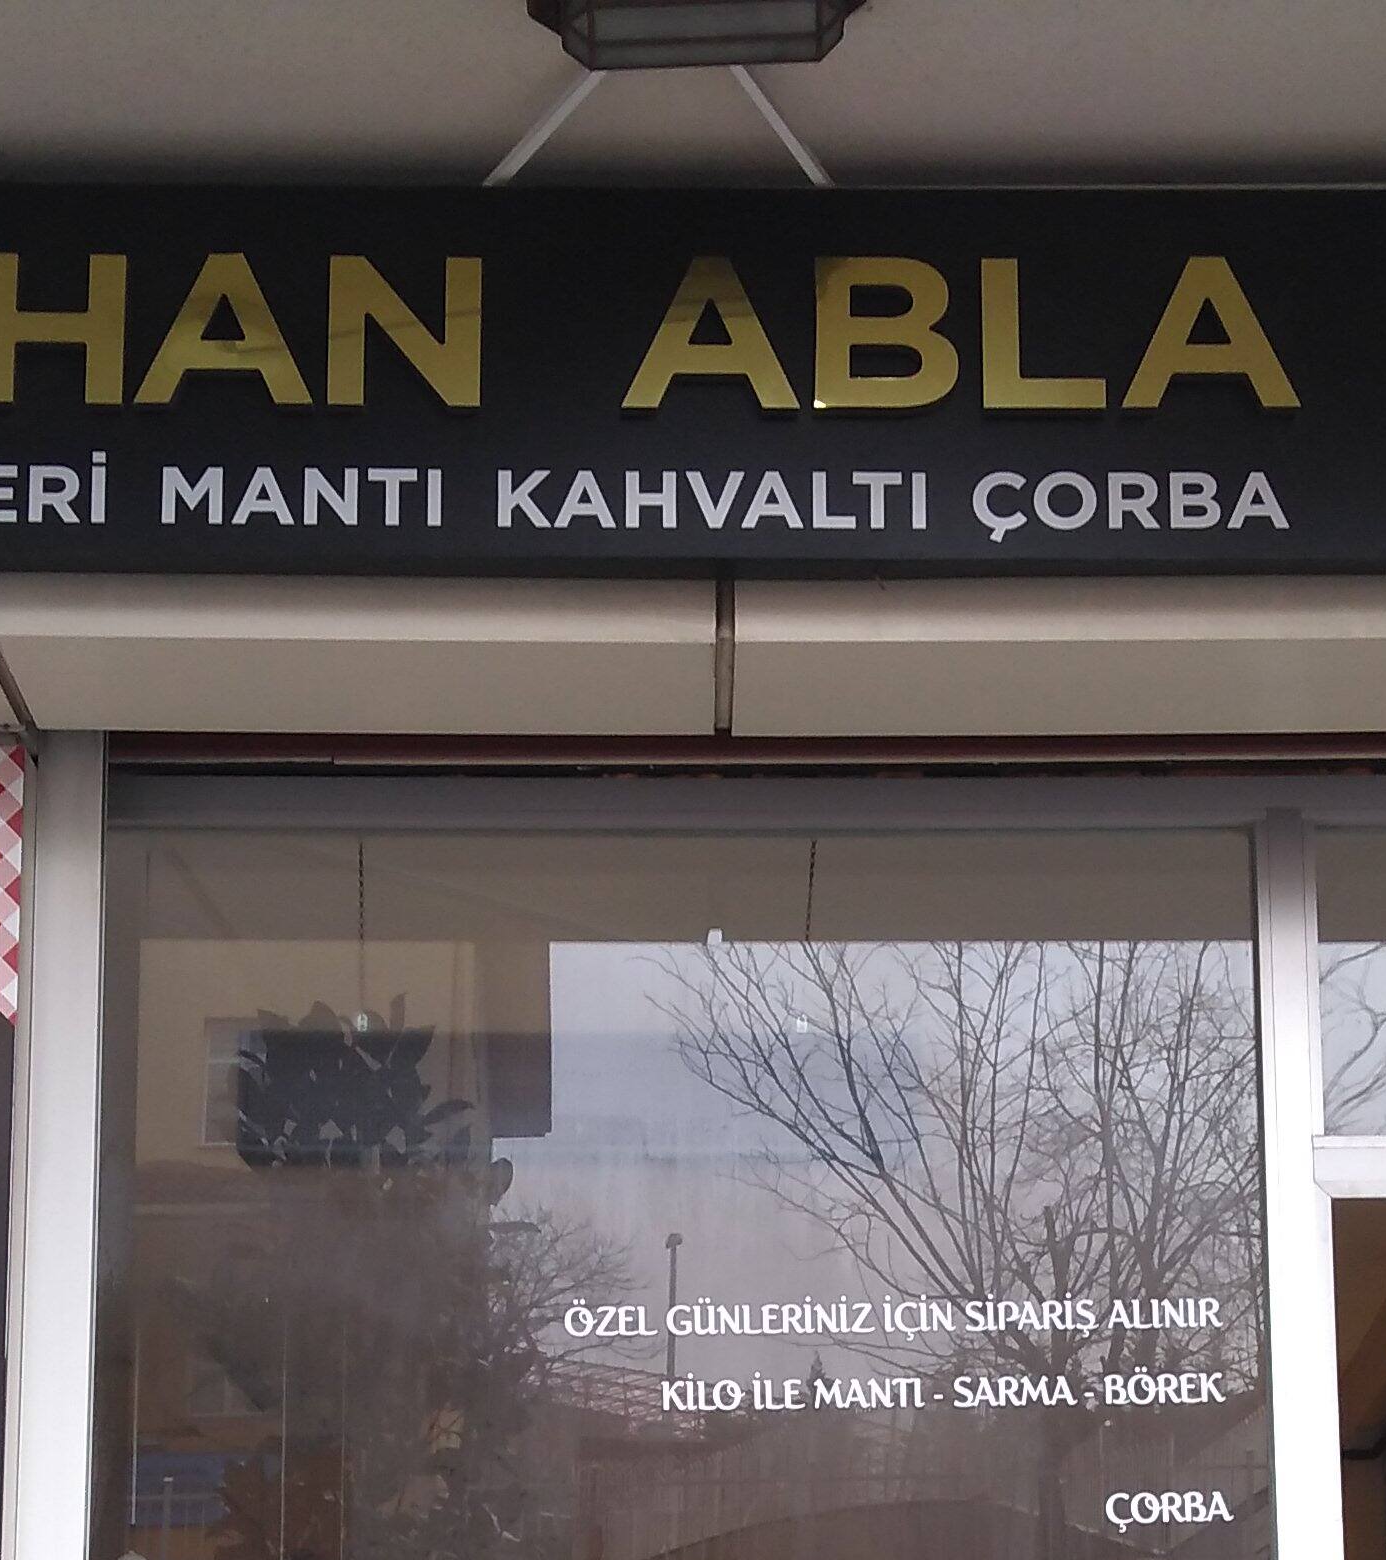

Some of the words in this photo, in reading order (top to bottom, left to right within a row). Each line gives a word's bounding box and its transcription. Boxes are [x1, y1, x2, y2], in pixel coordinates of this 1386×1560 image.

[620, 256, 1301, 410] ABLA
[160, 466, 443, 528] MANTI
[497, 470, 928, 531] KAHVALTI
[972, 470, 1290, 543] ÇORBA
[563, 1298, 658, 1337] ÖZEL
[665, 1296, 875, 1335] GÜNLERİNİZ
[883, 1295, 956, 1341] İÇİN
[965, 1293, 1099, 1337] SİPARİŞ
[1107, 1297, 1223, 1330] ALINIR
[661, 1372, 745, 1412] KİLO
[752, 1371, 806, 1411] İLE
[813, 1376, 925, 1410] MANTI
[953, 1374, 1079, 1408] SARMA
[1103, 1366, 1226, 1405] BÖREK
[1104, 1492, 1234, 1534] ÇORBA
